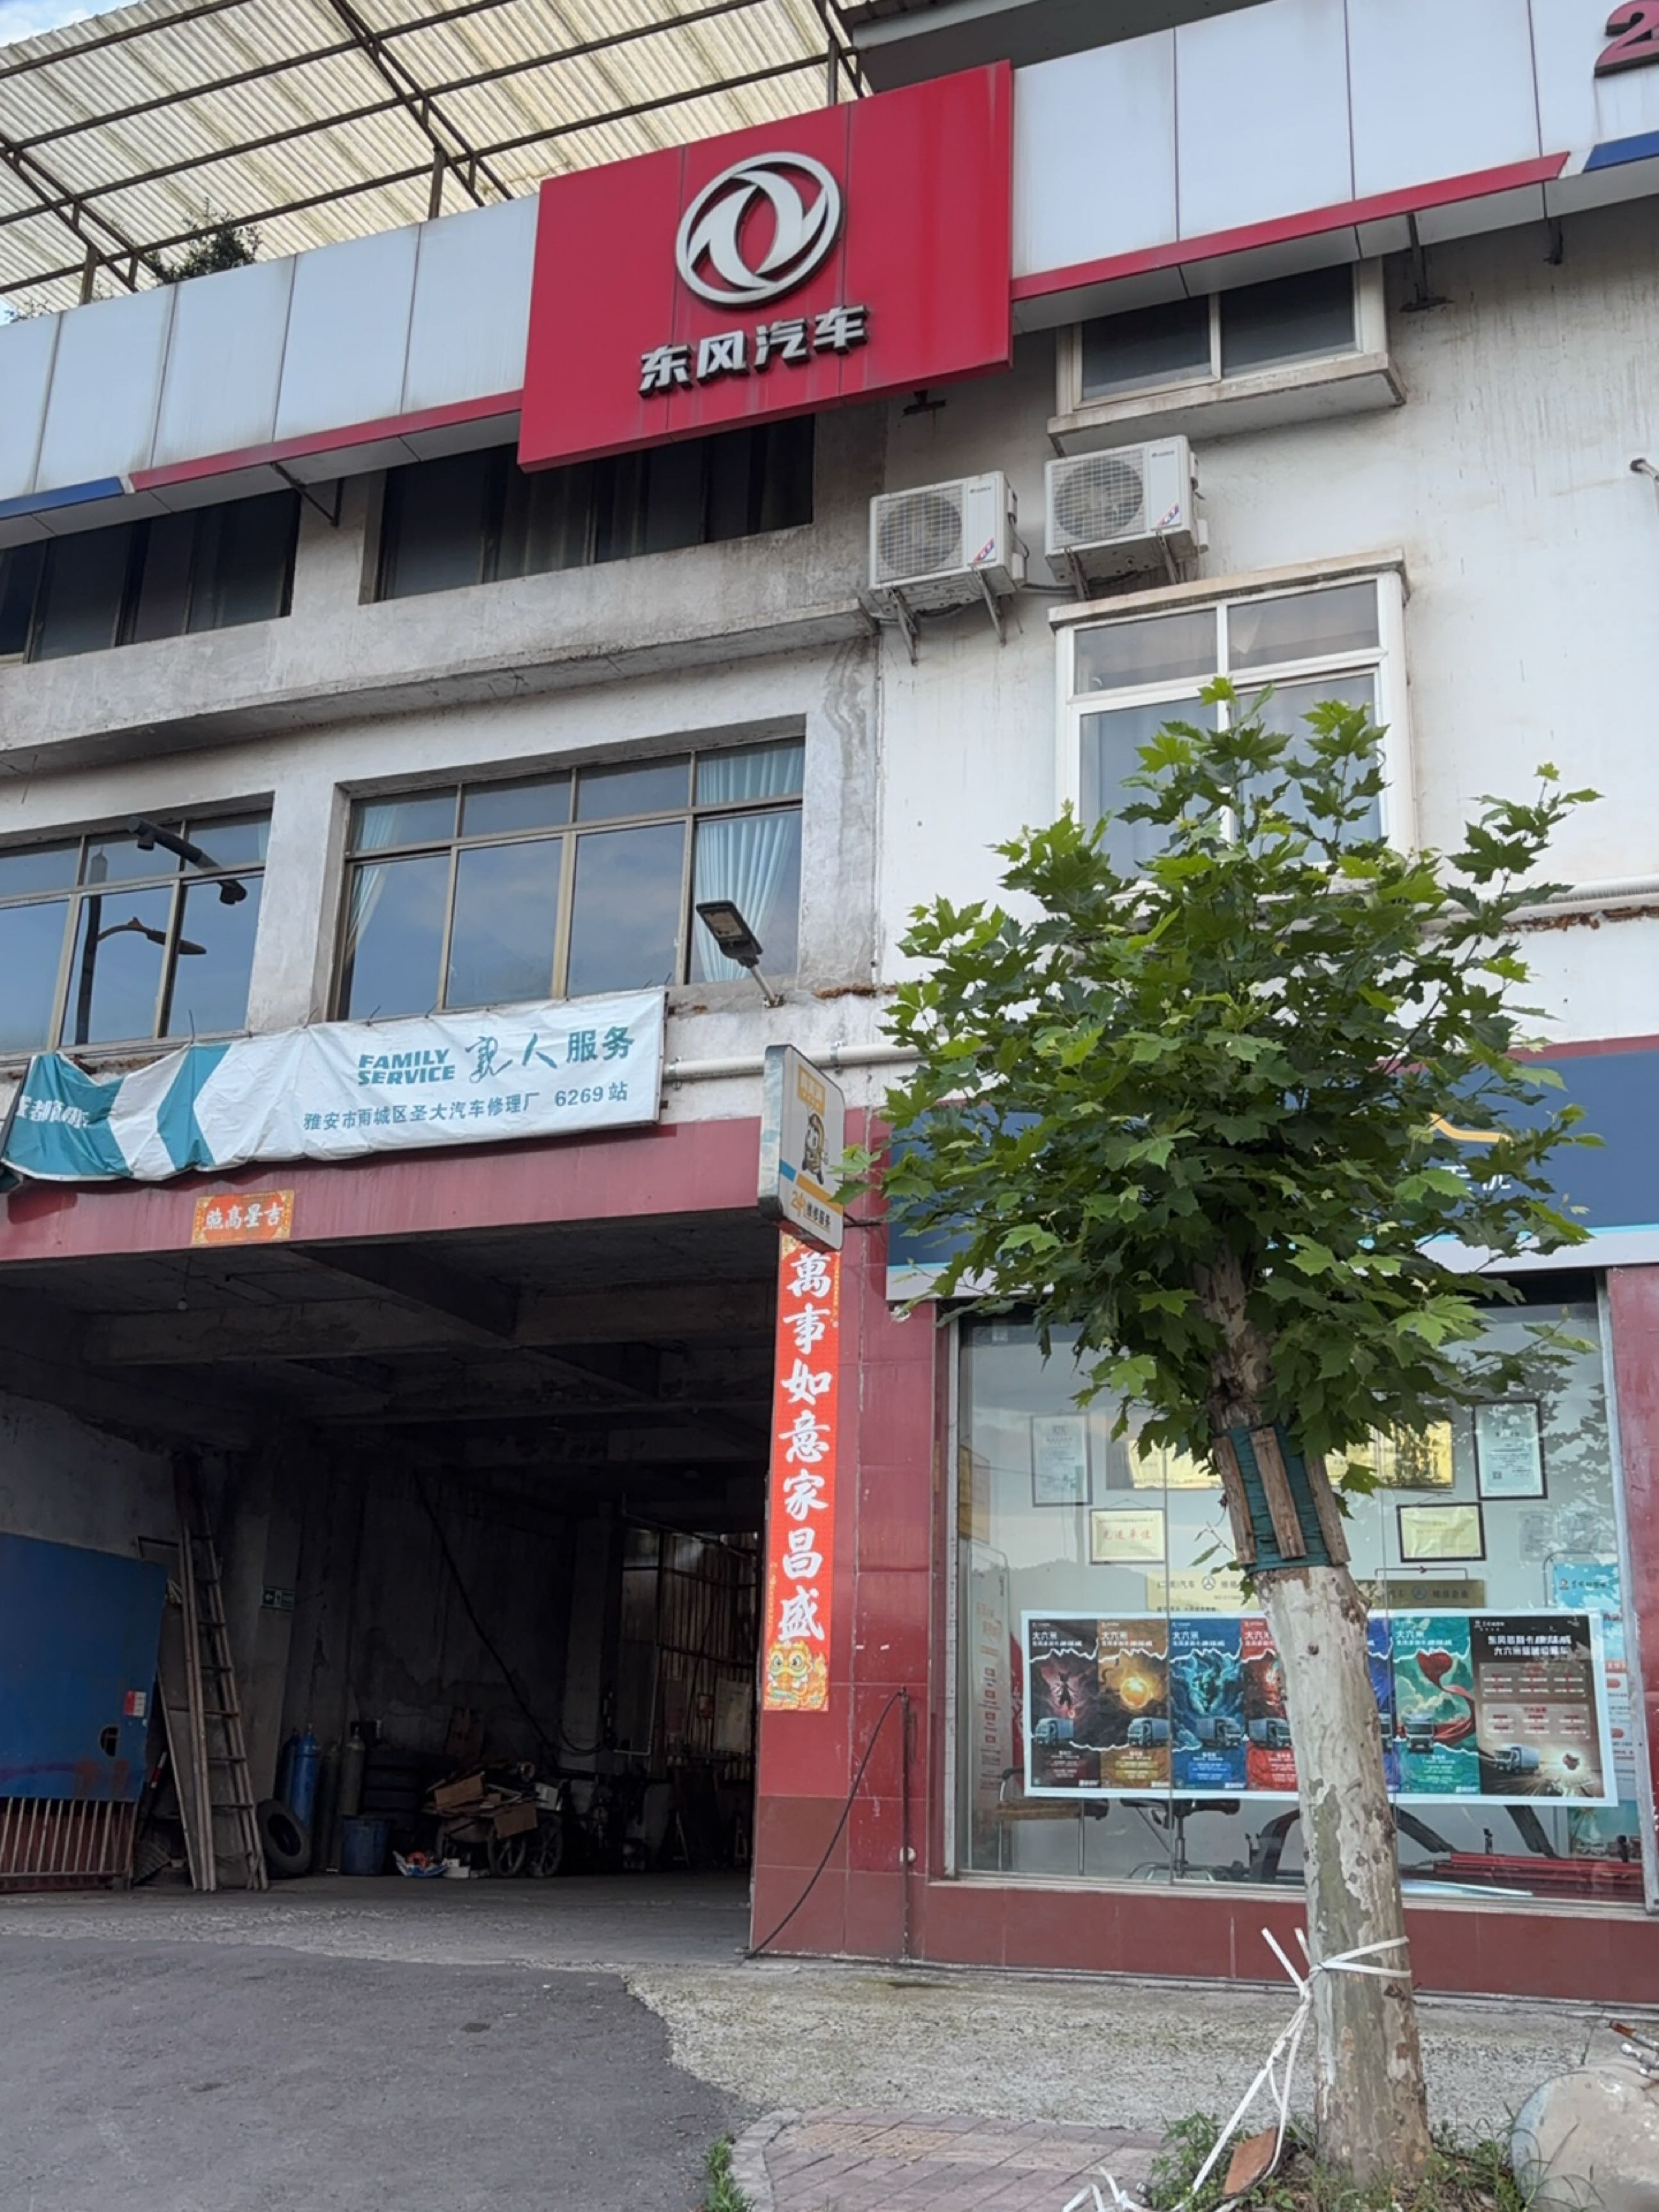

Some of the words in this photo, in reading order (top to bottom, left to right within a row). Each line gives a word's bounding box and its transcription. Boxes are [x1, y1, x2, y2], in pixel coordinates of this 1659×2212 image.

[638, 303, 869, 397] 东风汽车
[358, 1049, 450, 1068] FAMILY
[358, 1066, 455, 1086] SERVICE
[303, 1091, 540, 1131] 雅安市雨城区圣大汽车修理厂
[778, 1251, 832, 1642] 萬事如意家昌盛
